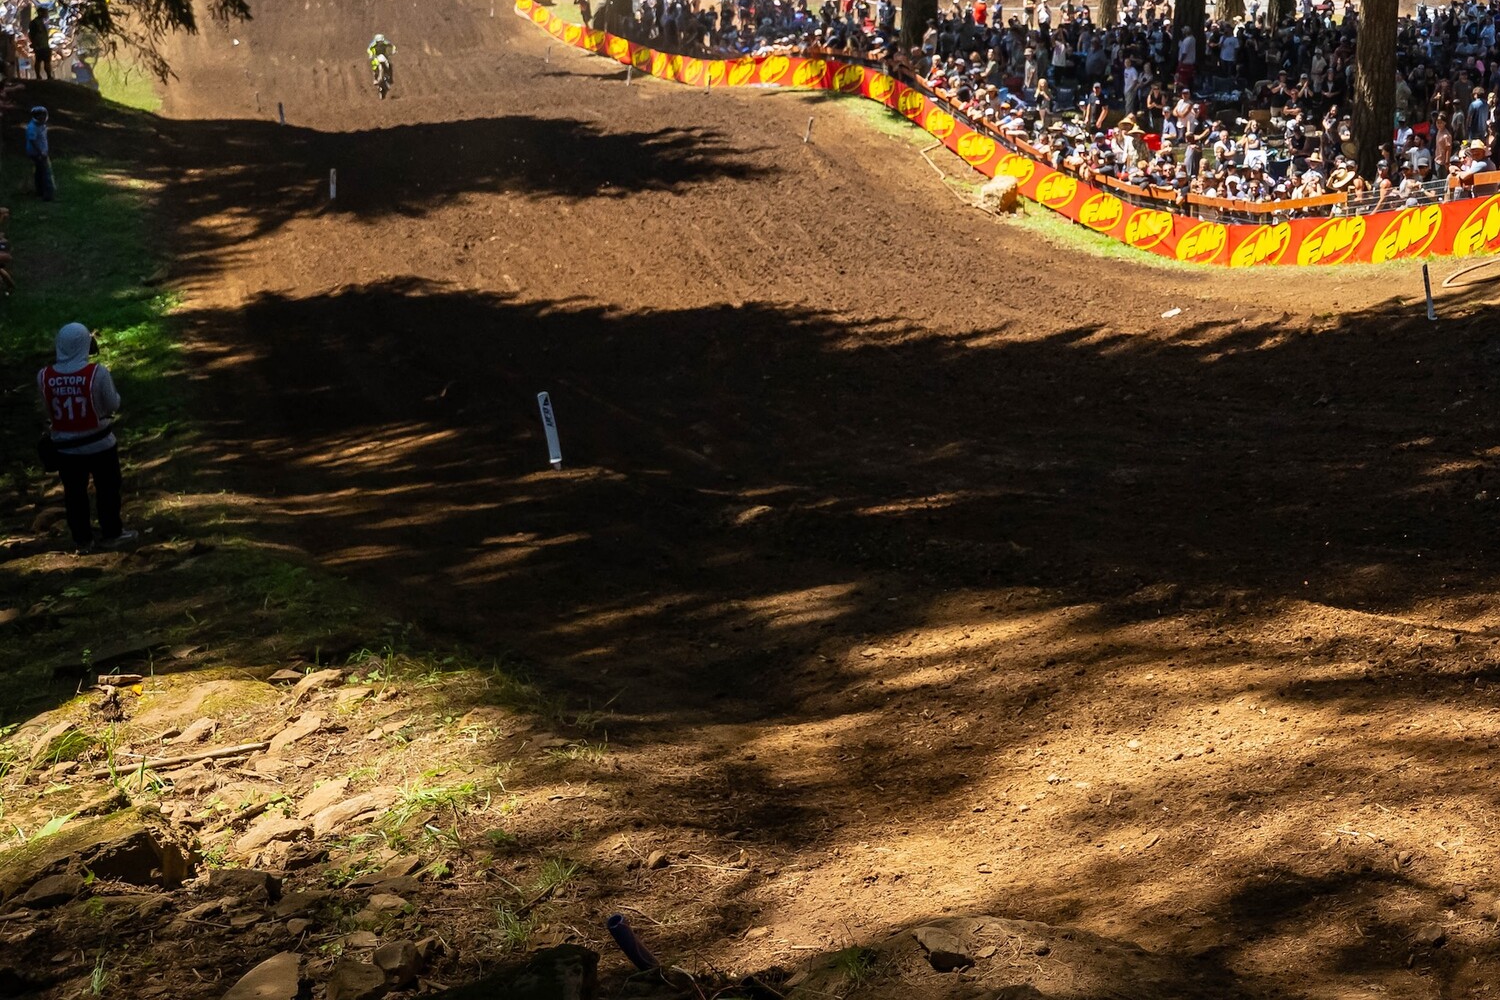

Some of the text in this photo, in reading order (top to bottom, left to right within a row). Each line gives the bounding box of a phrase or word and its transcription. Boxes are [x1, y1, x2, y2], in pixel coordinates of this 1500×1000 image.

[1037, 175, 1077, 203] FMF
[1080, 194, 1123, 225] FMF
[1126, 211, 1172, 244] FMF
[1177, 223, 1226, 262] FMF
[1233, 222, 1289, 267] FMF
[1299, 216, 1364, 265] FMF
[1374, 204, 1441, 263] FMF
[48, 375, 87, 387] OCTOPI
